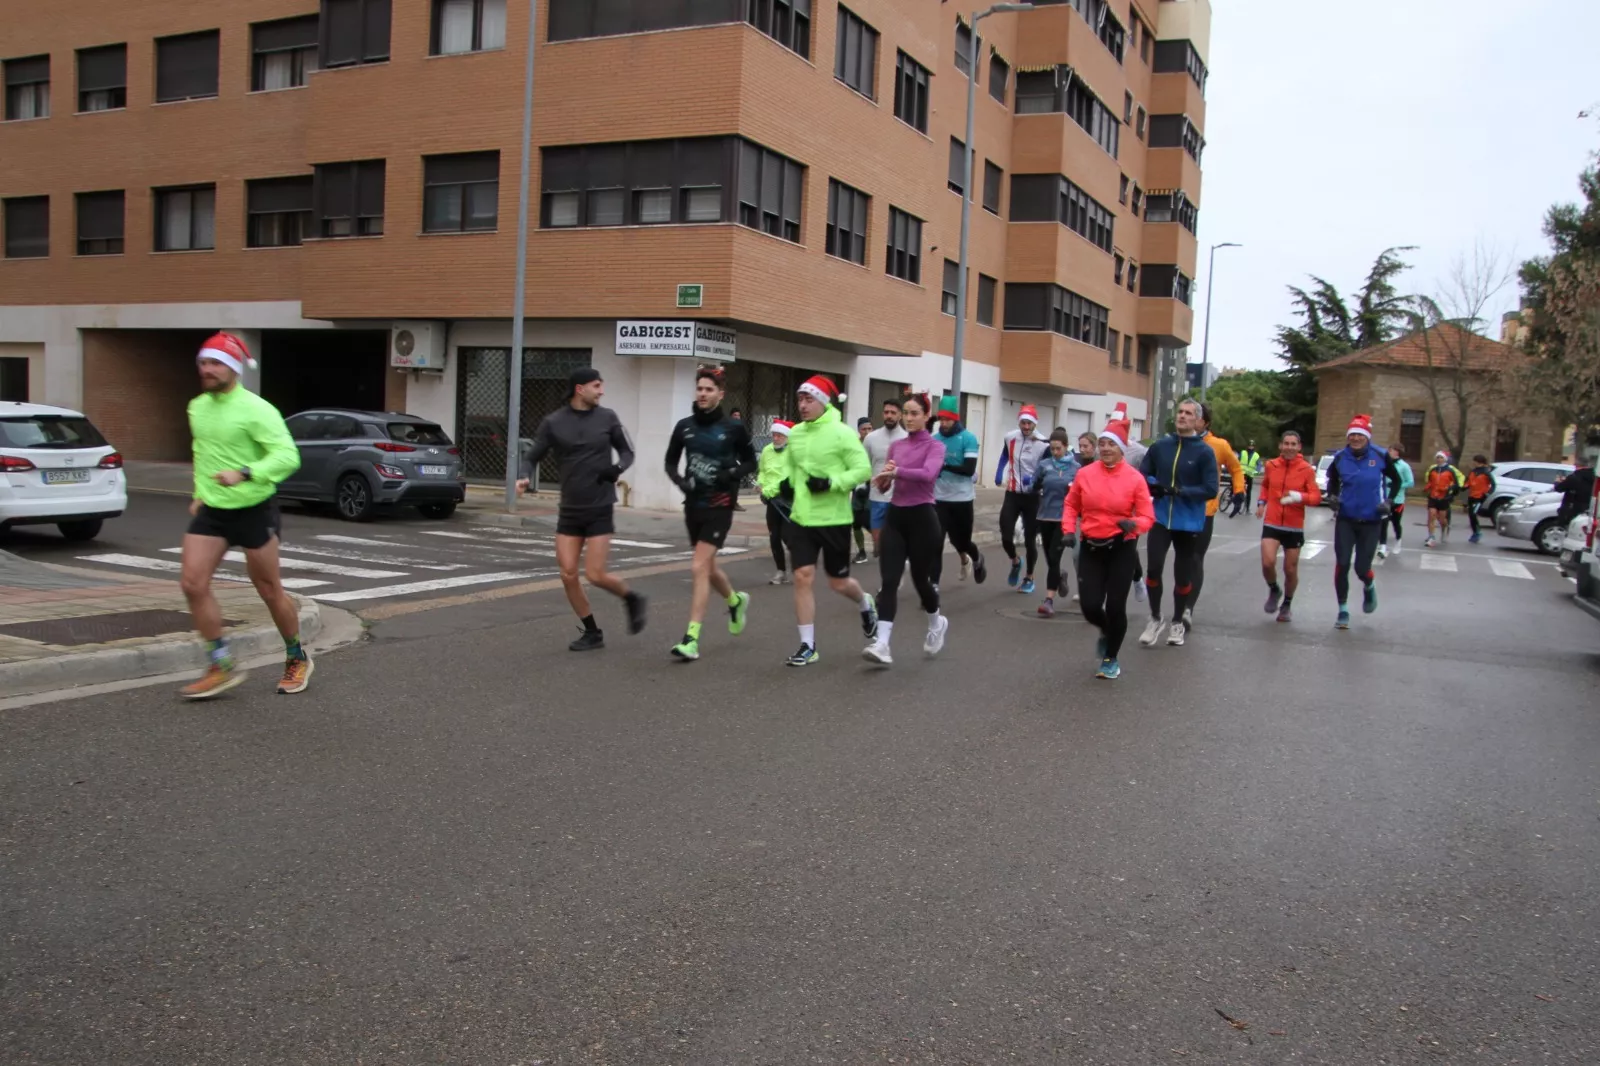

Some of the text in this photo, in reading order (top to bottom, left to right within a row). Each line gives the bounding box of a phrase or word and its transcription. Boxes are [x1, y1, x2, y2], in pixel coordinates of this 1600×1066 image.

[620, 325, 691, 338] GABIGEST
[696, 327, 735, 344] GABIGEST
[650, 343, 691, 351] EMPRESARIAL
